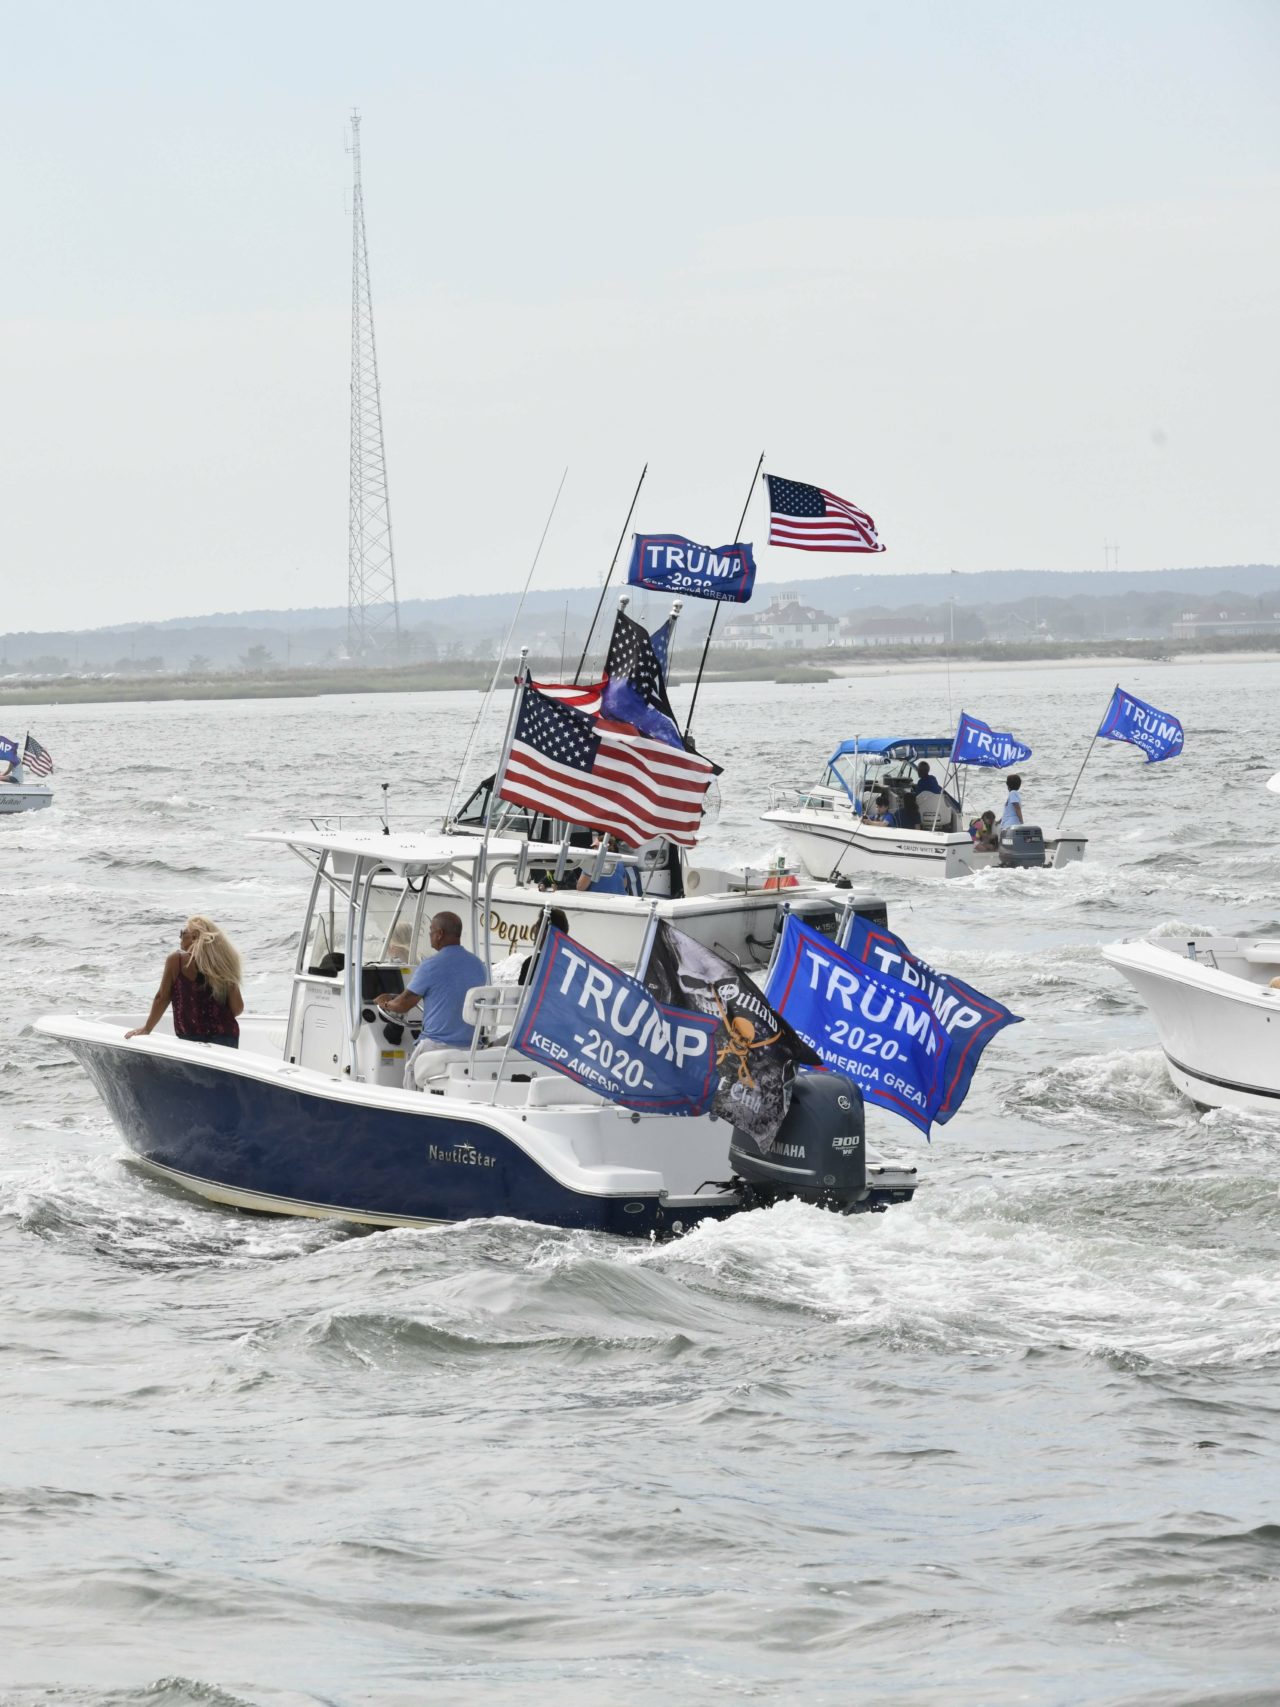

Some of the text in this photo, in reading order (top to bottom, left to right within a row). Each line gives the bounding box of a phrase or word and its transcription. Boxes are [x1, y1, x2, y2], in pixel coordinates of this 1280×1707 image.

[646, 545, 741, 578] TRUMP
[1124, 699, 1183, 745] TRUMP
[1130, 729, 1165, 751] -2020-
[560, 946, 708, 1070] TRUMP
[529, 1031, 625, 1095] KEEP AMERIC
[573, 1028, 654, 1091] -2020-
[794, 1029, 817, 1050] EEP
[816, 1046, 879, 1081] AMERICA
[824, 1020, 908, 1063] -2020-
[429, 1144, 497, 1168] NauticStar
[770, 1140, 806, 1158] AMAHA
[832, 1135, 860, 1147] 300
